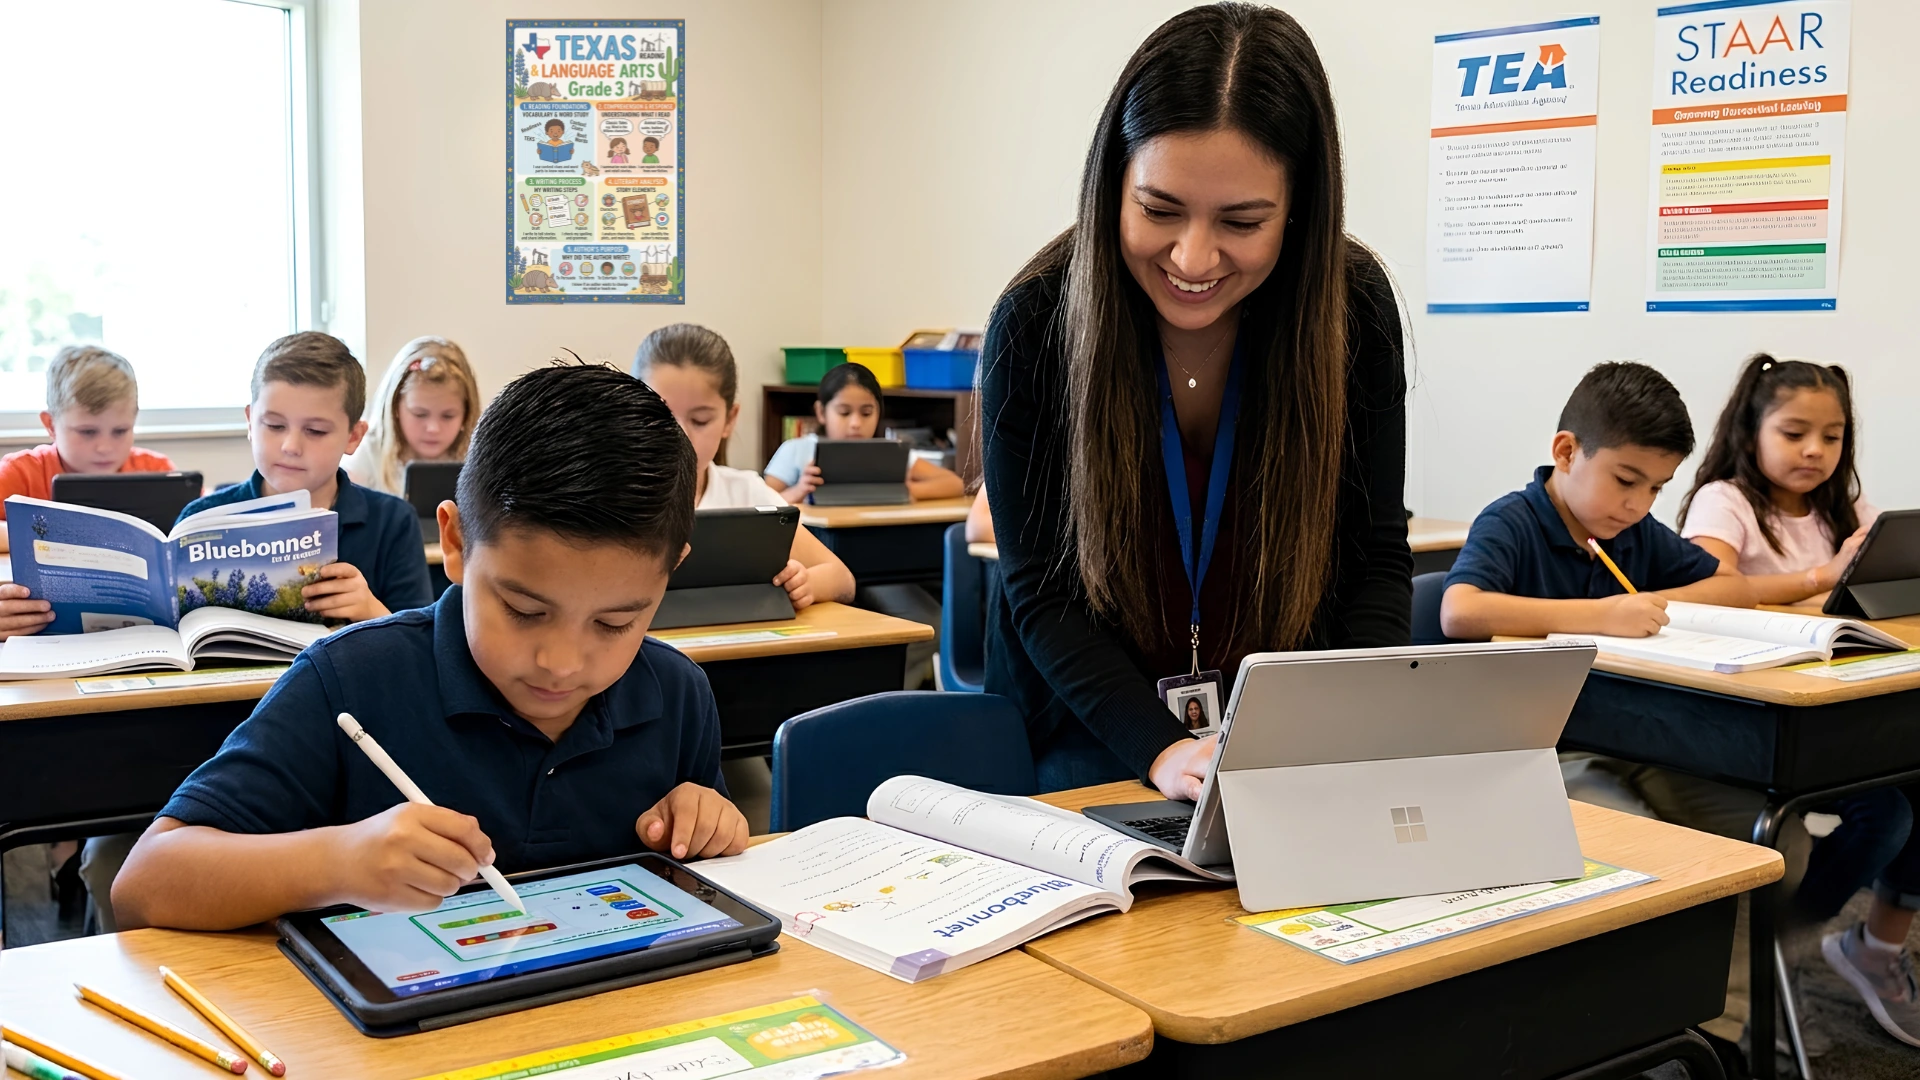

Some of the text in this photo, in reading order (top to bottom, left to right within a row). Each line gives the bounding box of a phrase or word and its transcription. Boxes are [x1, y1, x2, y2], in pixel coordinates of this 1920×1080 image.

[555, 35, 636, 61] TEXAS
[1676, 12, 1824, 62] STAAR
[530, 64, 655, 78] & LANGUAGE ARTS
[1457, 44, 1567, 97] TEA
[1672, 62, 1828, 95] Readiness
[568, 81, 624, 96] Grade 3
[188, 530, 322, 562] Bluebonnet
